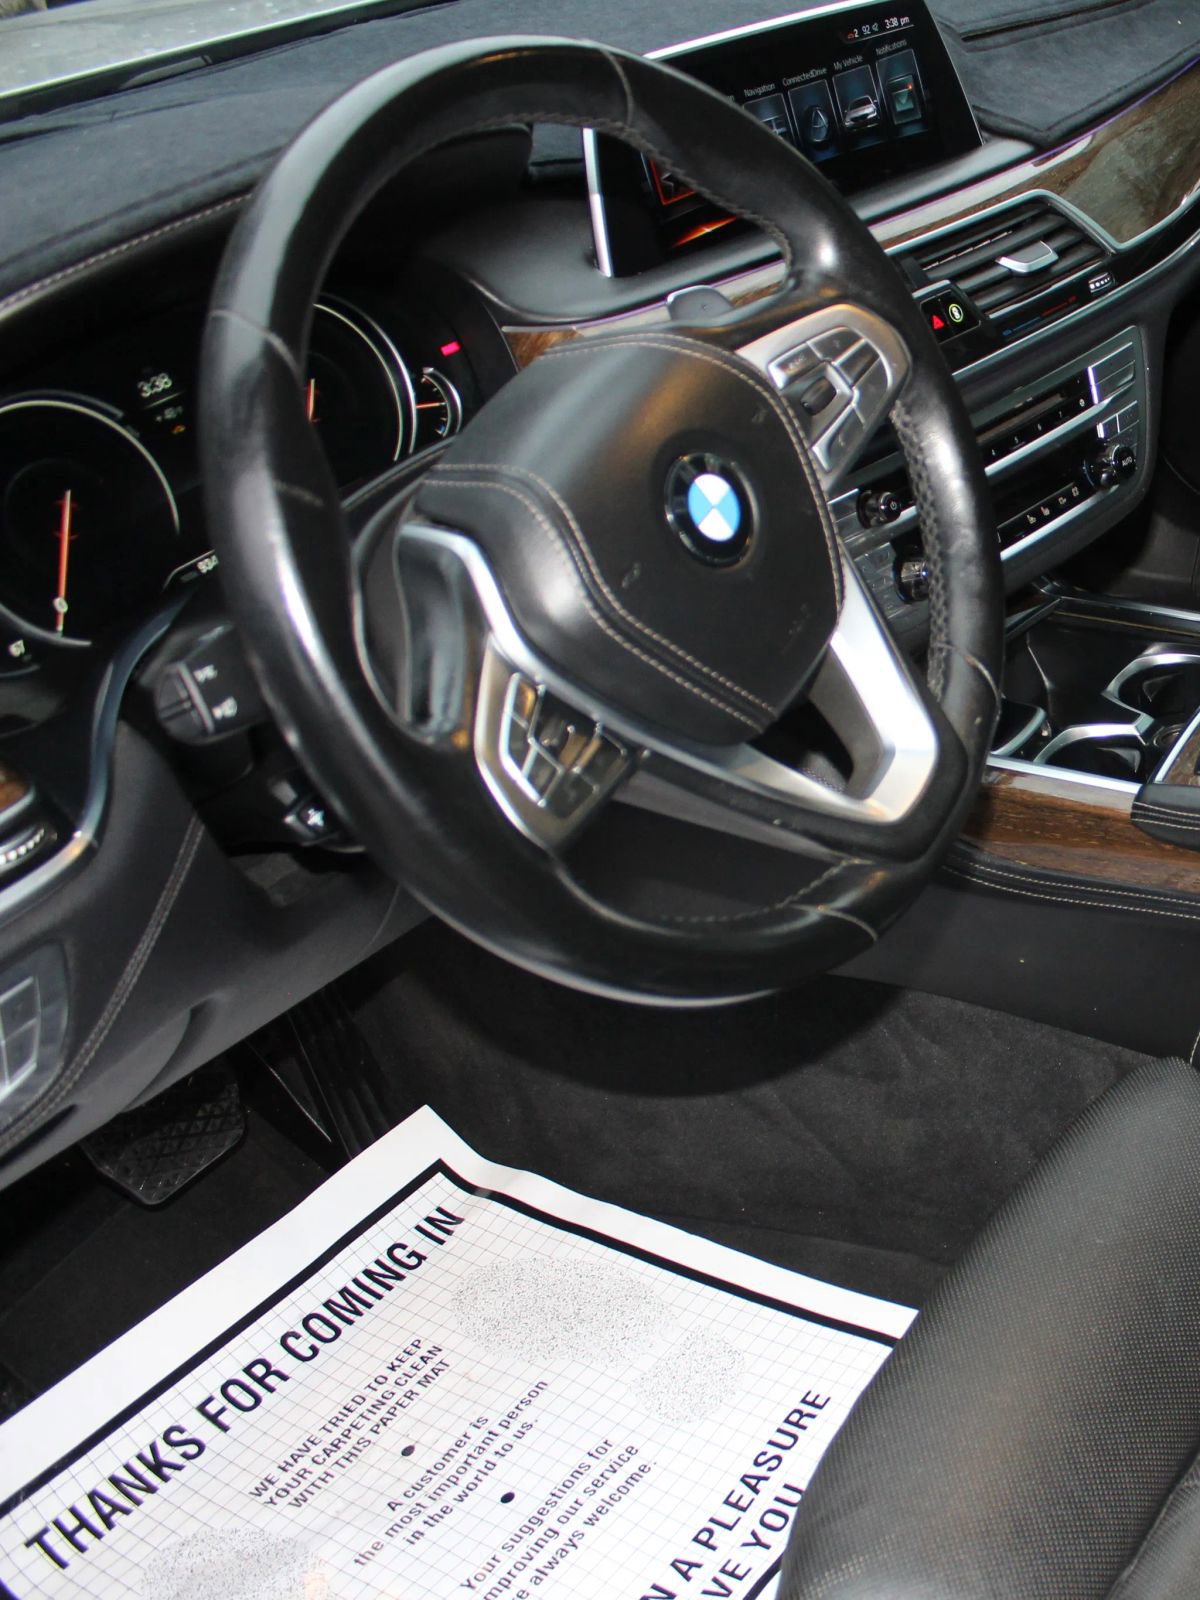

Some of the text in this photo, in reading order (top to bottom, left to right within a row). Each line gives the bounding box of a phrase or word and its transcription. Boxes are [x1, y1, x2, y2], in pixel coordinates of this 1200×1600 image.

[744, 82, 775, 97] Navigation
[884, 16, 899, 29] 3:38
[137, 373, 173, 398] 3:38
[24, 1206, 466, 1570] THANKS FOR COMING IN
[249, 1338, 423, 1498] WE HAVE TRIED TO KEEP
[264, 1345, 444, 1507] YOUR CARPETING CLEAN
[288, 1358, 450, 1509] WITH THIS PAPER MAT
[386, 1415, 490, 1512] A customer is
[353, 1380, 549, 1567] the most important person
[402, 1418, 539, 1546] in the world to us.
[460, 1553, 502, 1591] Your
[501, 1461, 592, 1553] suggestions
[587, 1438, 615, 1461] for
[483, 1444, 639, 1600] mproving our service
[529, 1461, 658, 1586] always welcome.
[670, 1558, 704, 1583] A
[691, 1390, 832, 1552] PLEASURE
[700, 1482, 806, 1598] VE YOU
